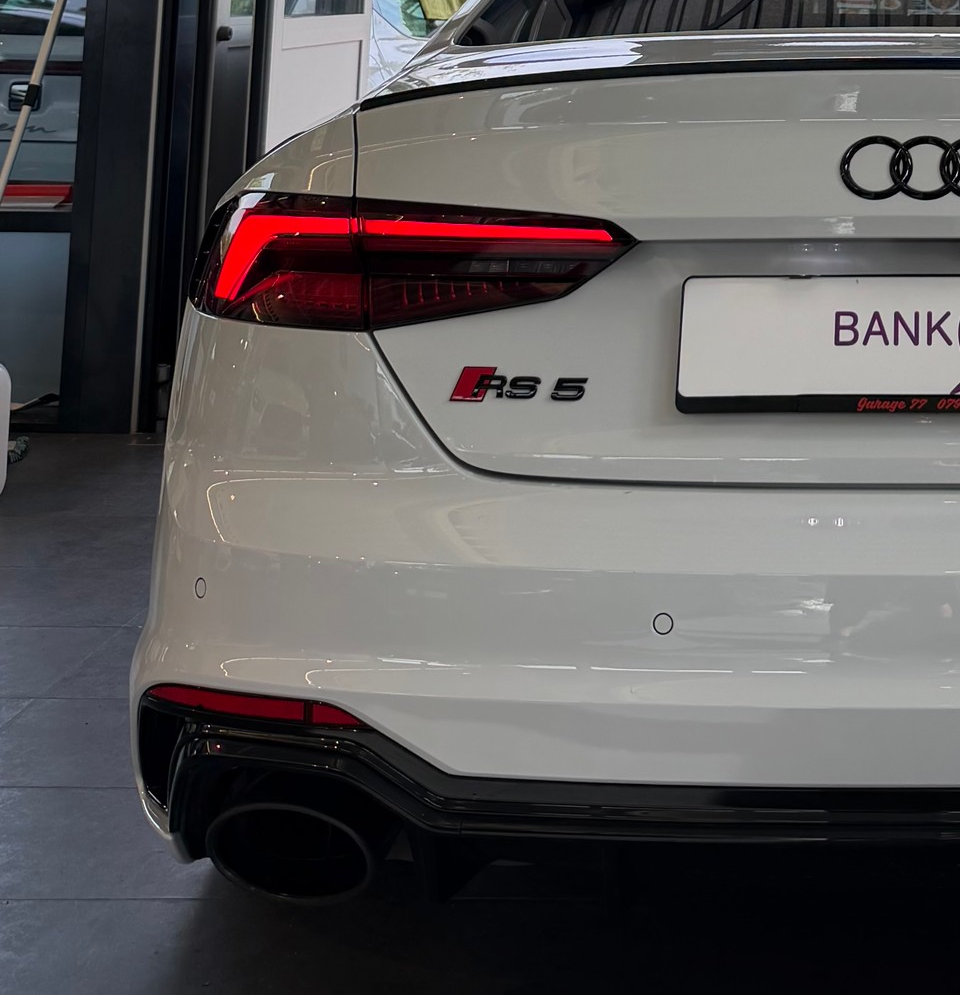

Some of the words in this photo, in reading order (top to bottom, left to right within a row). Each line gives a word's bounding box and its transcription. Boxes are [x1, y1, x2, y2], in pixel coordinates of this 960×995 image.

[833, 310, 953, 347] BANK
[468, 374, 542, 400] RS
[551, 377, 589, 401] 5
[857, 397, 906, 412] Garage
[910, 398, 928, 409] 77
